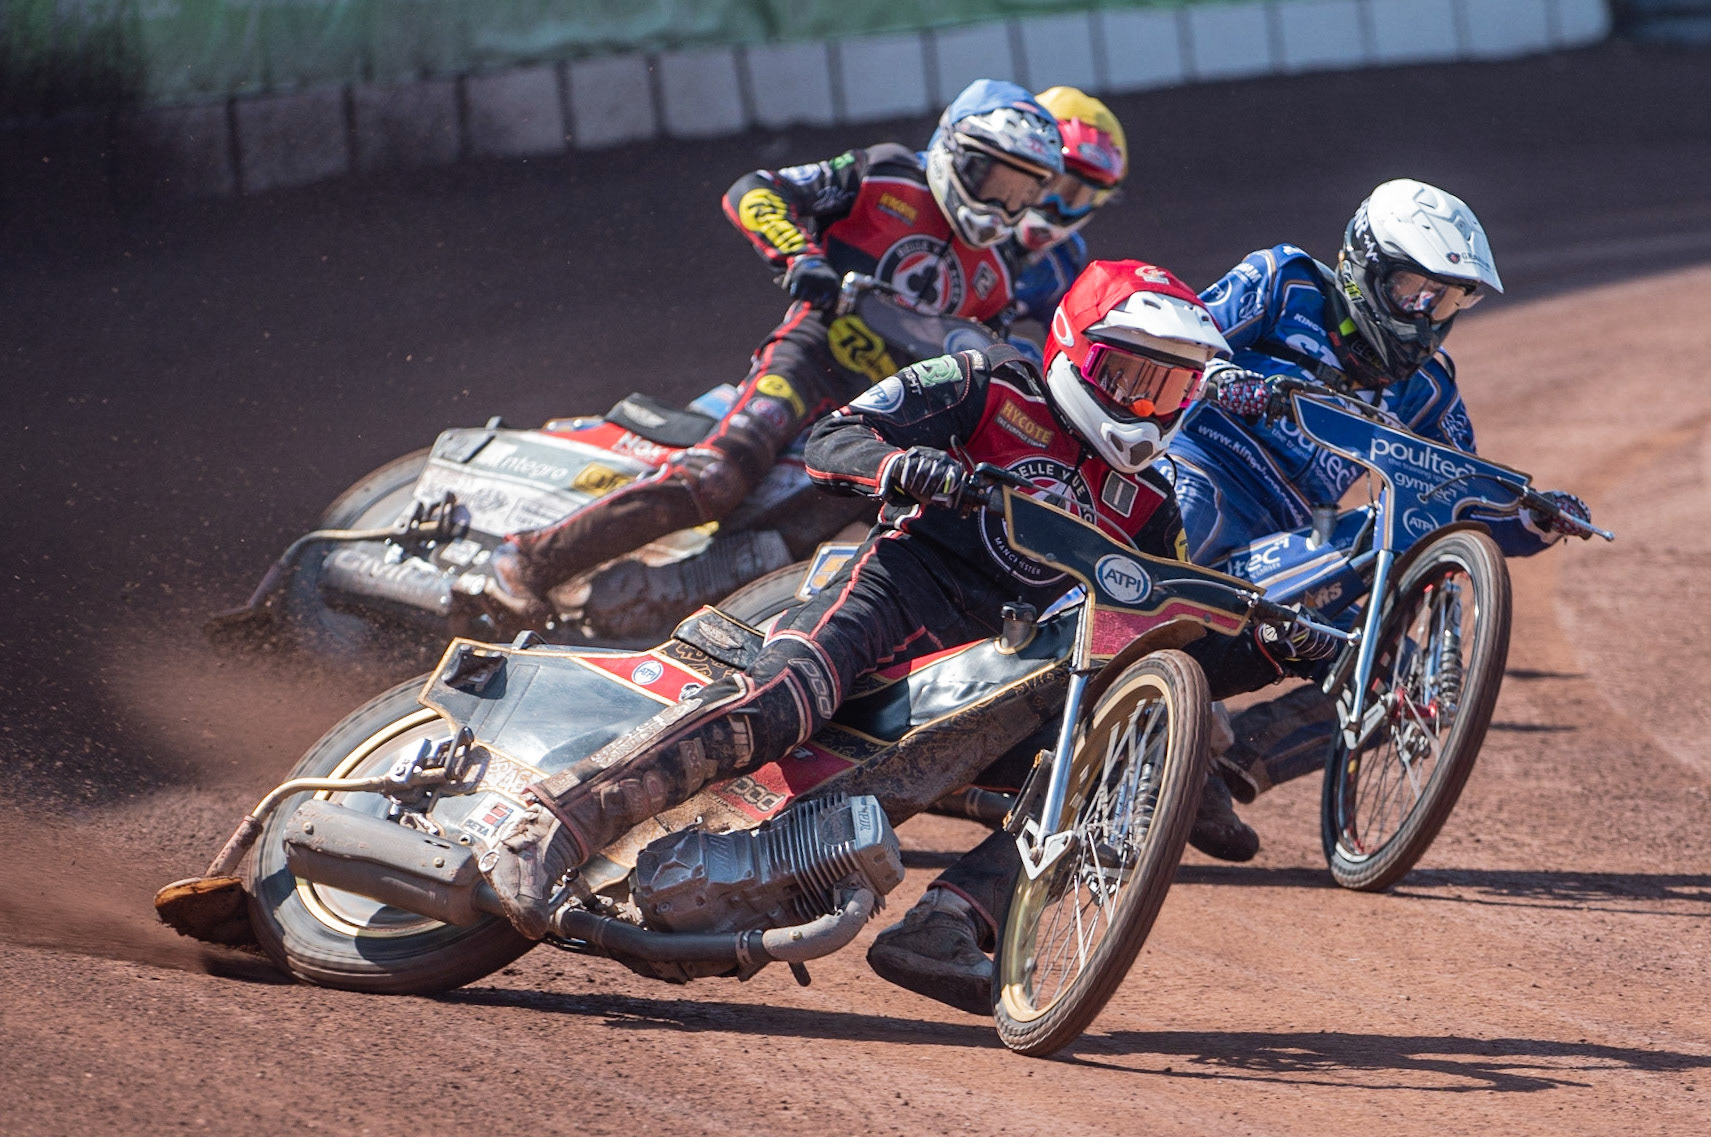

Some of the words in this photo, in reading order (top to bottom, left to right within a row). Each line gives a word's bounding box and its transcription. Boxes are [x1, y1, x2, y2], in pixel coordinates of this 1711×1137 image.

[1001, 402, 1052, 443] HYCOTE
[1370, 437, 1468, 486] poultec
[1104, 568, 1141, 593] ATPI
[637, 666, 657, 680] ATPI
[464, 819, 490, 836] BETA
